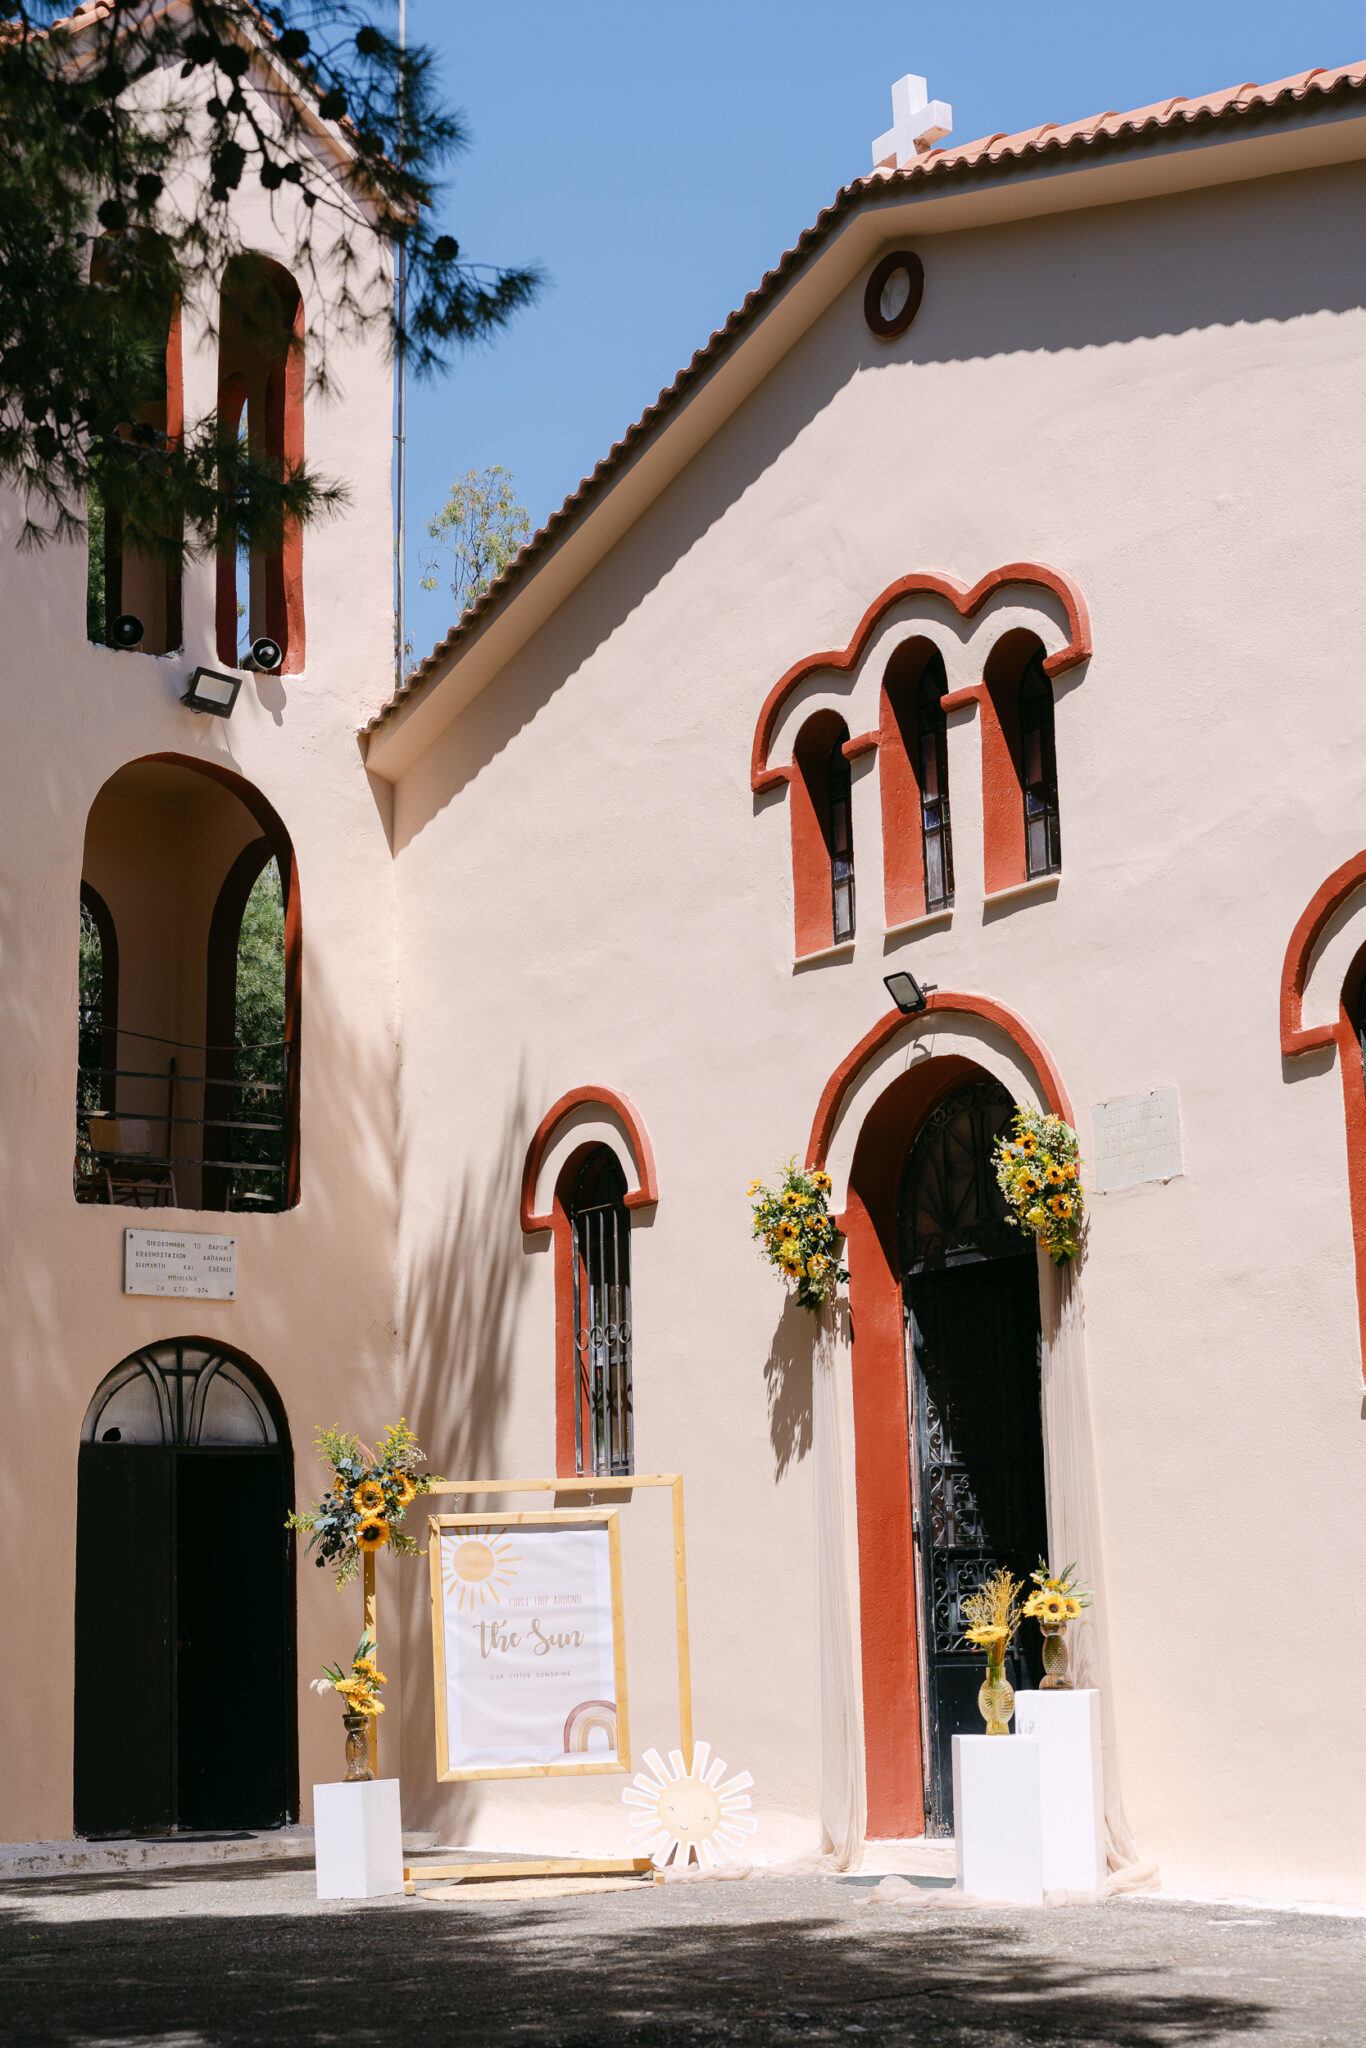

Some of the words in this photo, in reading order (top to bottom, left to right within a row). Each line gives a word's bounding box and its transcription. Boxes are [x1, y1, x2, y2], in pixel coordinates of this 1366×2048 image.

[194, 1242, 201, 1250] ΤΟ
[509, 1596, 529, 1607] FIRST
[534, 1595, 549, 1606] TRIP
[553, 1594, 582, 1606] AROUND
[472, 1620, 522, 1659] the
[526, 1617, 585, 1656] Sun
[489, 1673, 504, 1681] OUR
[536, 1670, 571, 1678] SUNSHINE
